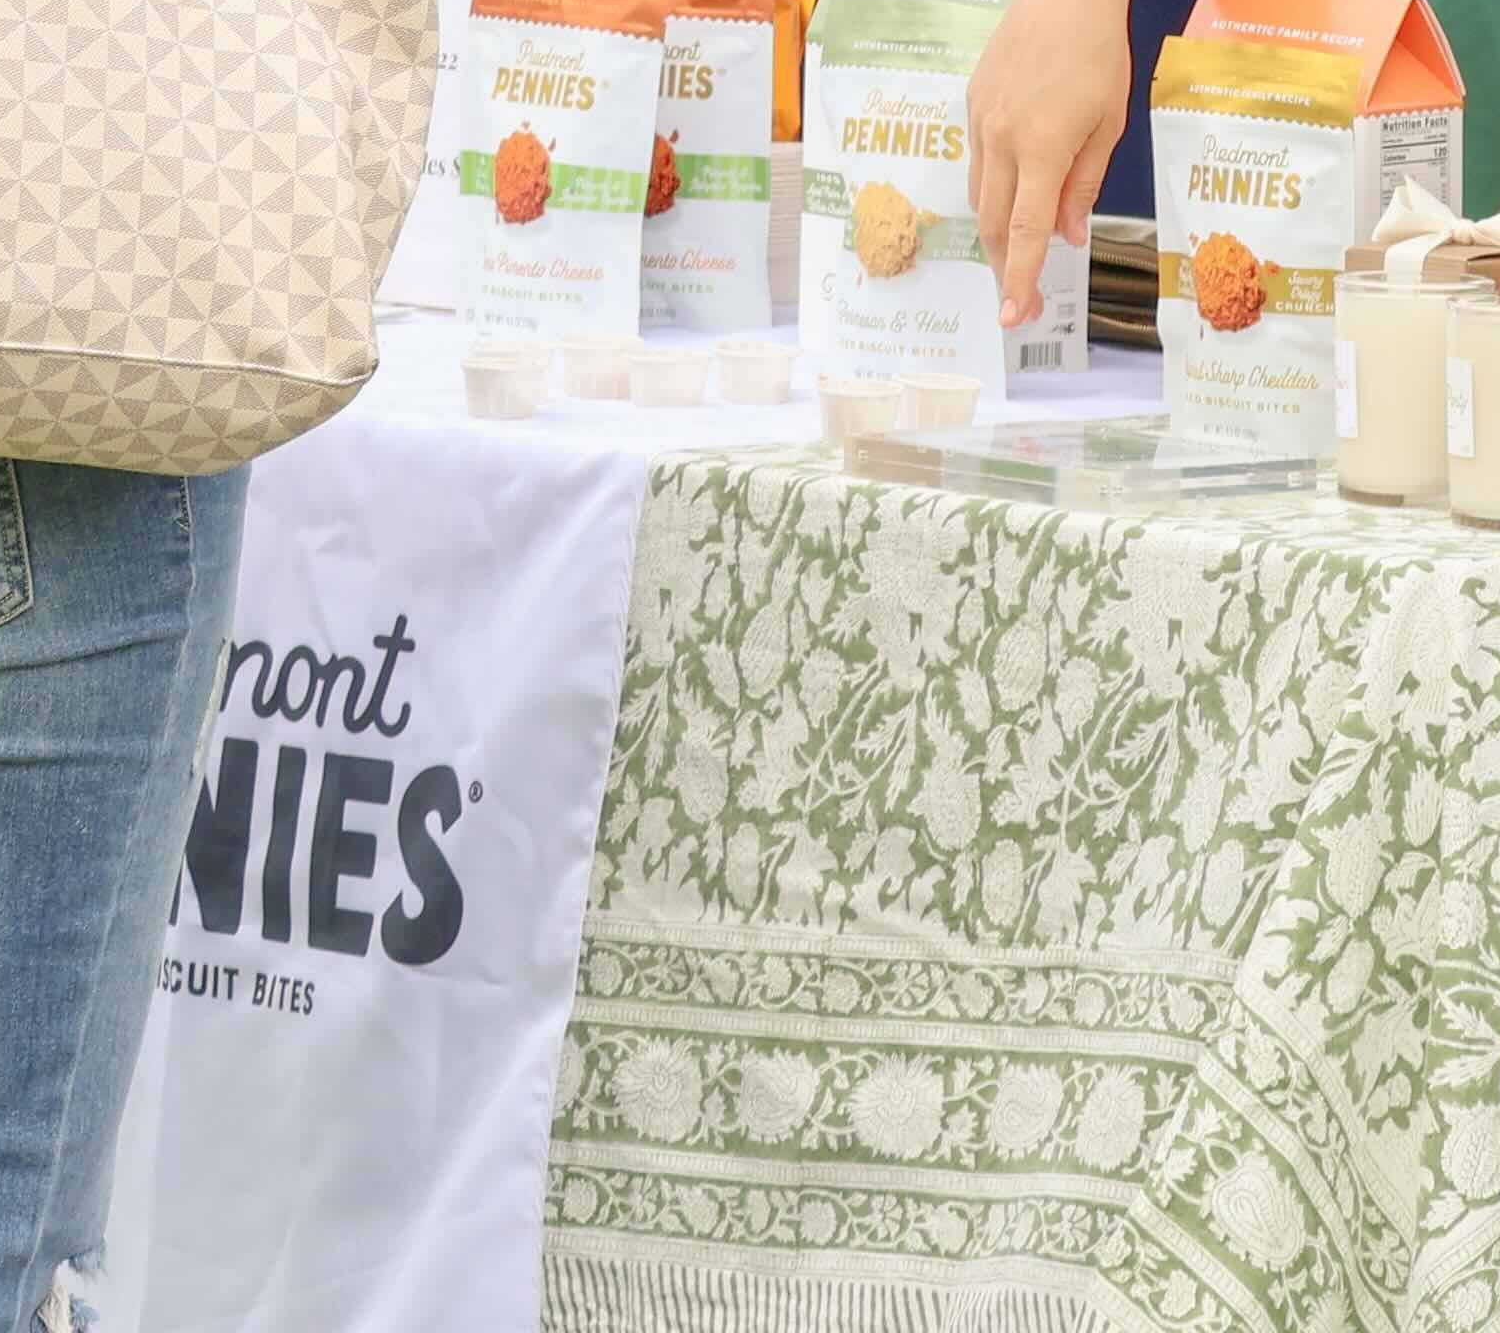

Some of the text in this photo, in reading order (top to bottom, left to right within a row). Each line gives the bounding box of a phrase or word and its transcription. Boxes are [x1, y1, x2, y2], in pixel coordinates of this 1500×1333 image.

[1211, 20, 1365, 48] AUTHENTIC FAMILY RECIPE
[492, 67, 596, 111] PENNIES
[1189, 83, 1240, 98] AUTHENTIC
[1274, 92, 1311, 107] RECIPE
[842, 116, 966, 161] PENNIES
[1203, 134, 1292, 168] Piedmont
[1187, 165, 1304, 211] PENNIES
[1249, 364, 1320, 391] Cheddar
[251, 970, 316, 1016] BITES
